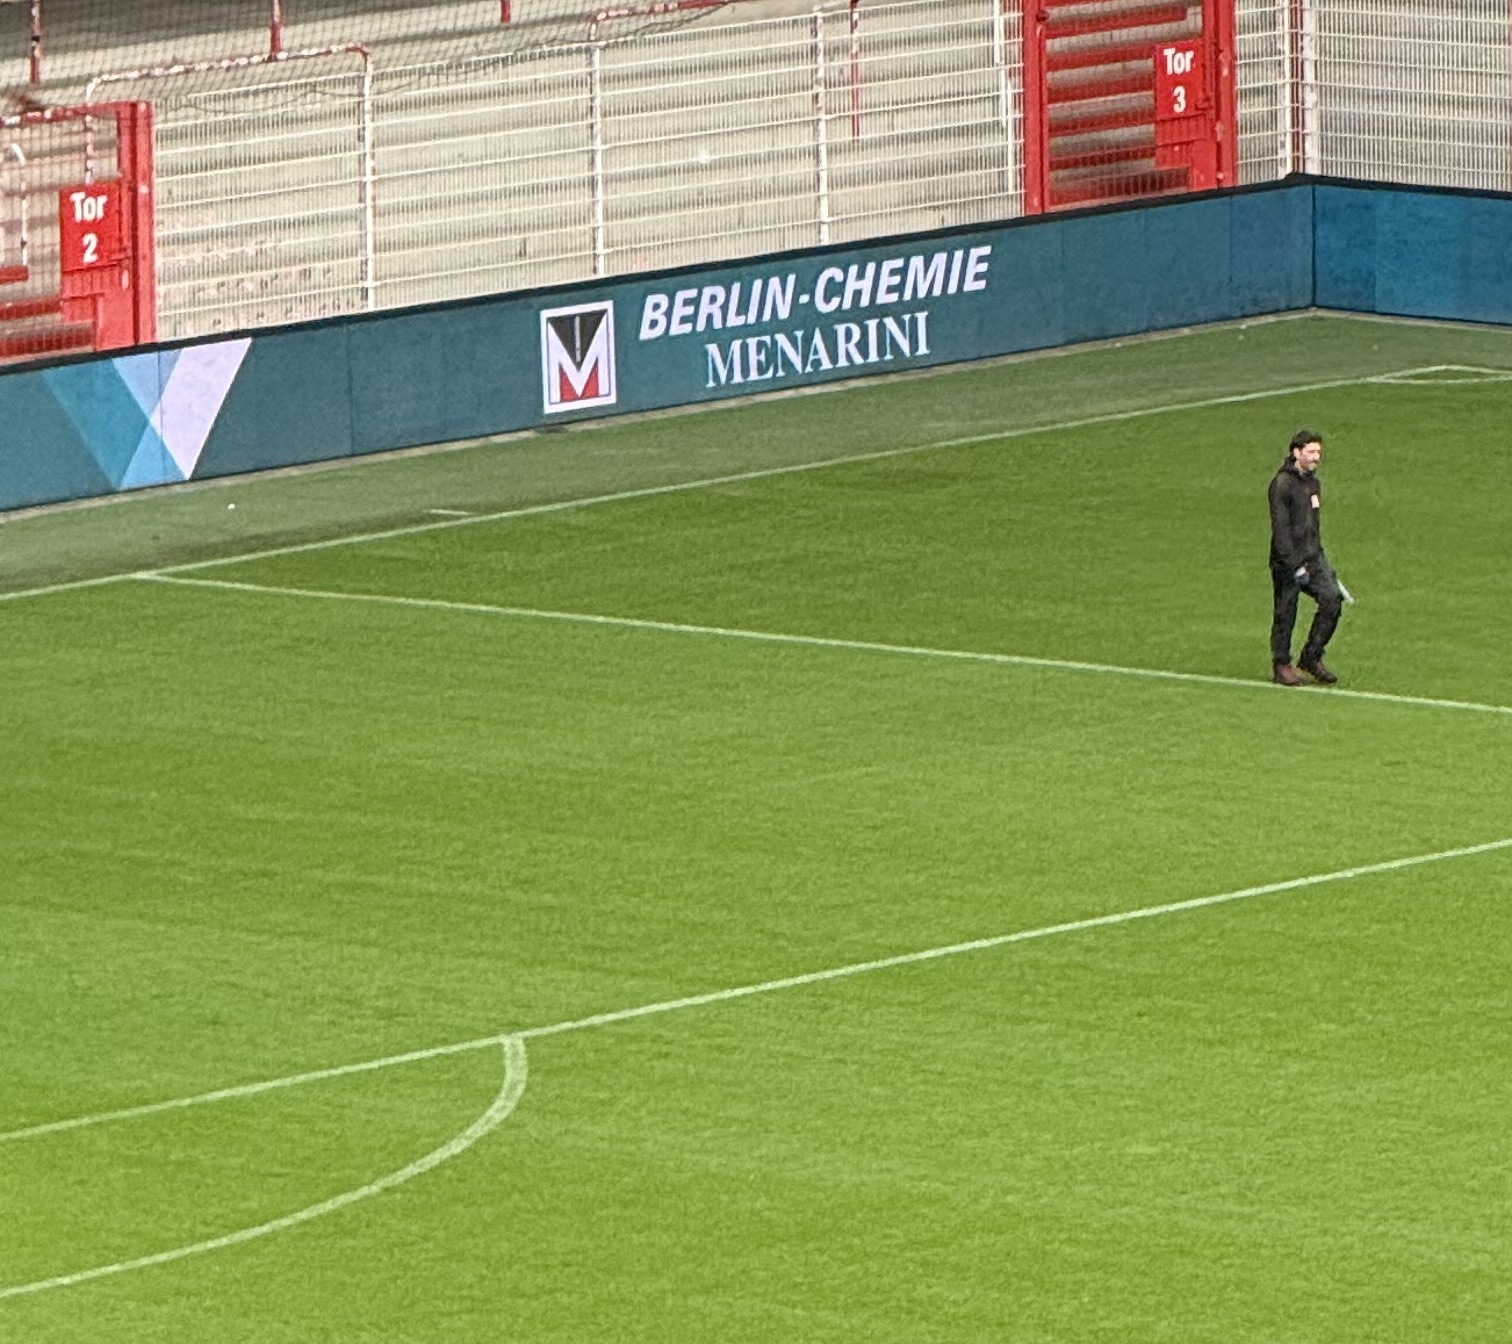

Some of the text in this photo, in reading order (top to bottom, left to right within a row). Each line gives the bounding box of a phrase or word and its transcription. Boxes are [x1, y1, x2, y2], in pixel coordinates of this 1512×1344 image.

[1164, 46, 1194, 75] Tor
[1172, 87, 1187, 113] 3
[70, 191, 107, 220] Tor
[82, 233, 98, 264] 2
[639, 245, 992, 340] BERLIN-CHEMIE
[705, 311, 931, 388] MENARINI
